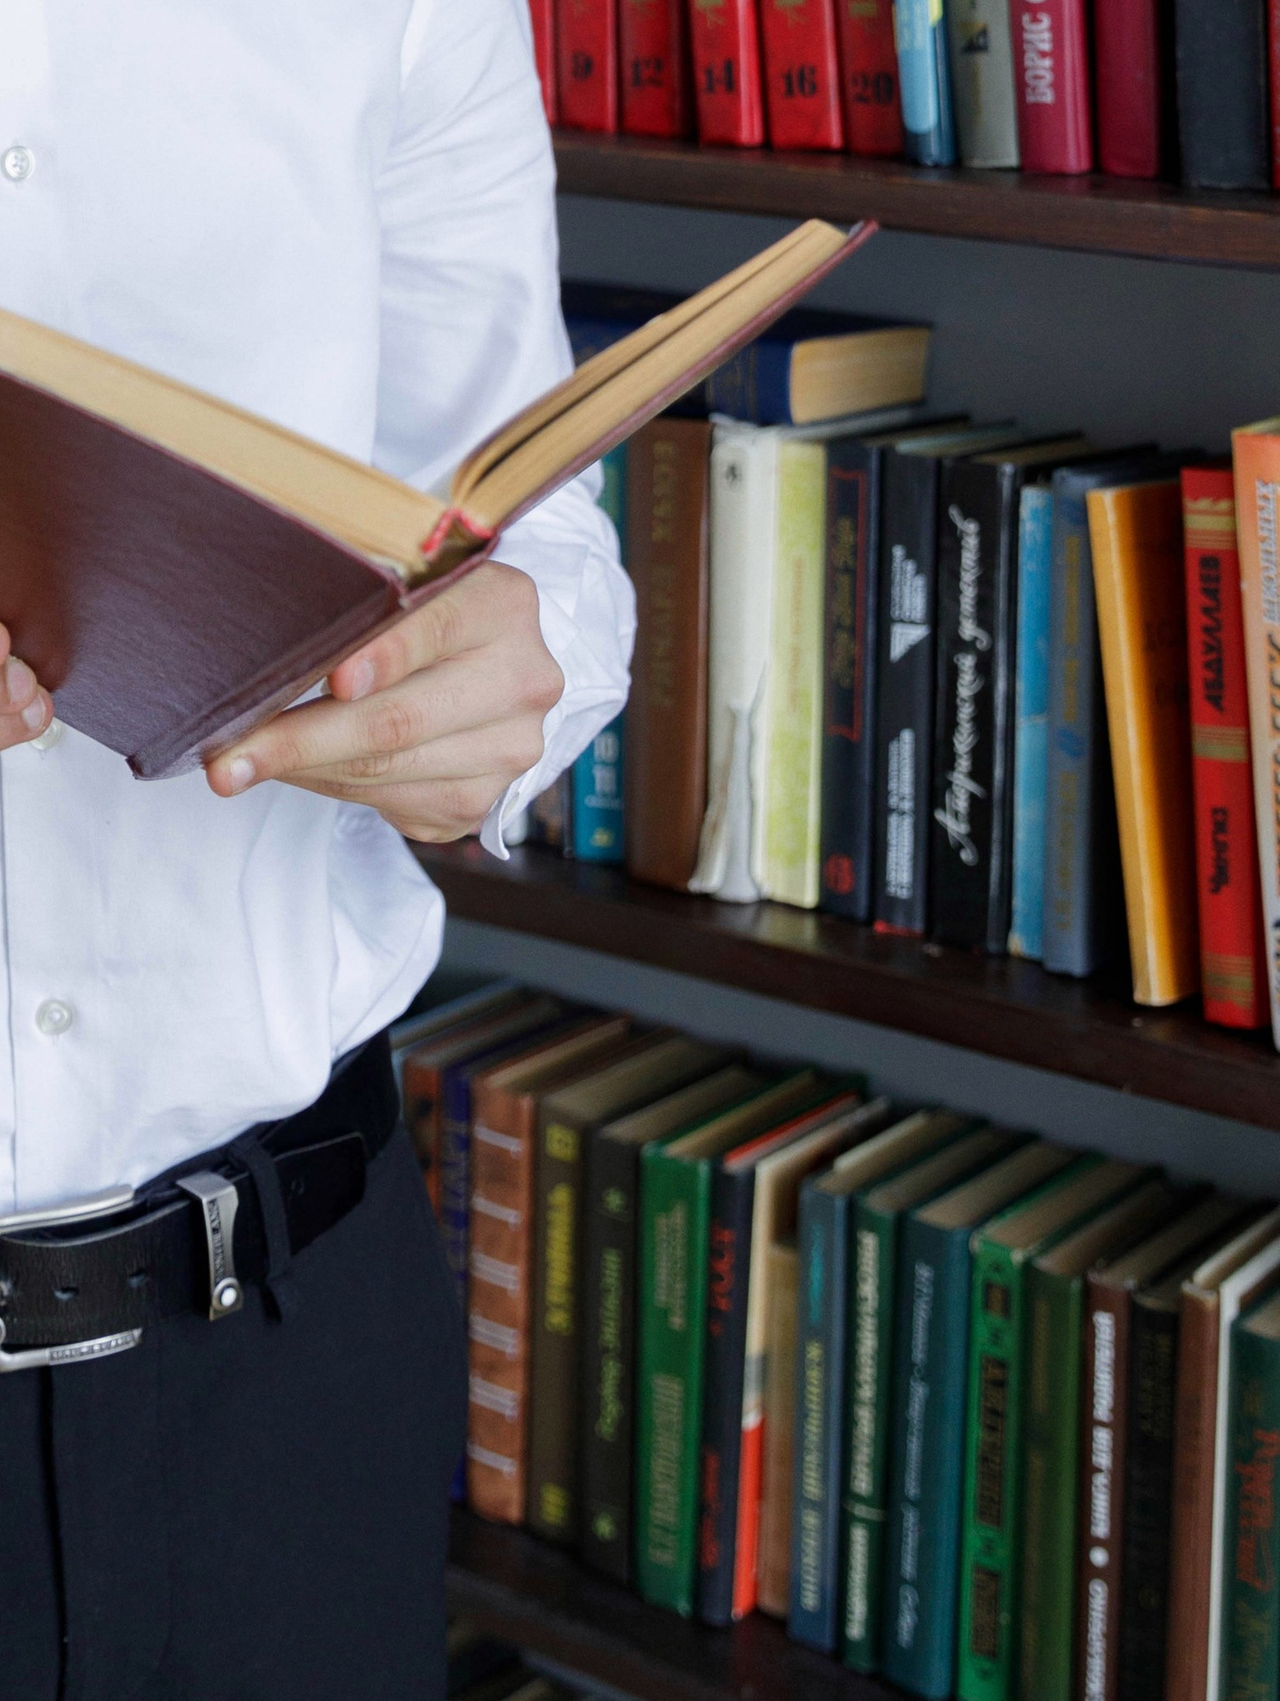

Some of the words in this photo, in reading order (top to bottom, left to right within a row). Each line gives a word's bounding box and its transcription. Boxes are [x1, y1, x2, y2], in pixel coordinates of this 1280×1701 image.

[631, 56, 663, 88] 12
[703, 57, 735, 96] 14
[780, 63, 820, 100] 16
[851, 72, 893, 106] 20
[1020, 11, 1056, 105] БОРИС
[948, 503, 992, 651] детектив
[1198, 554, 1224, 712] АБДУЛЛАЕВ
[933, 653, 987, 867] Американский
[1208, 806, 1230, 894] Чингиз
